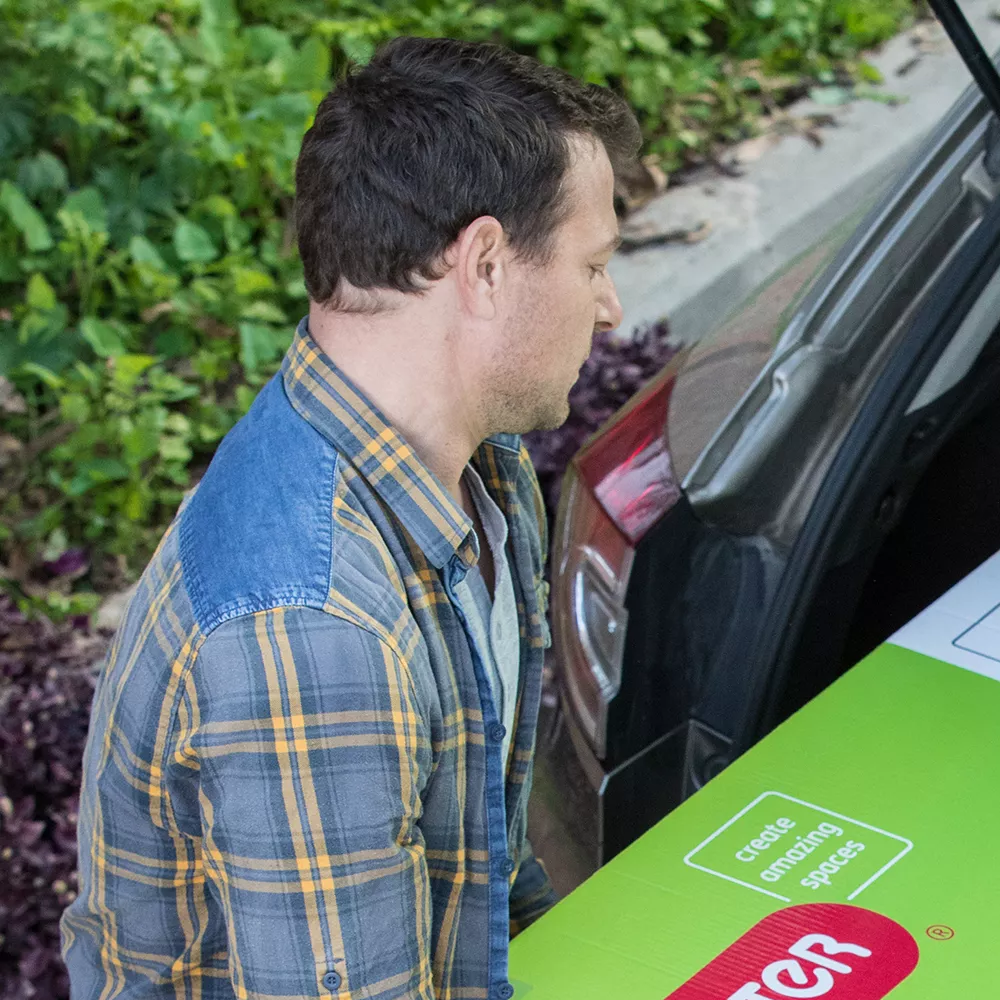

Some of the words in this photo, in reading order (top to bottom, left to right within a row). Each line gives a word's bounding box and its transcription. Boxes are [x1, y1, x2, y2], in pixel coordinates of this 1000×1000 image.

[736, 814, 796, 865] create
[758, 818, 845, 883] amazing
[799, 838, 866, 893] spaces
